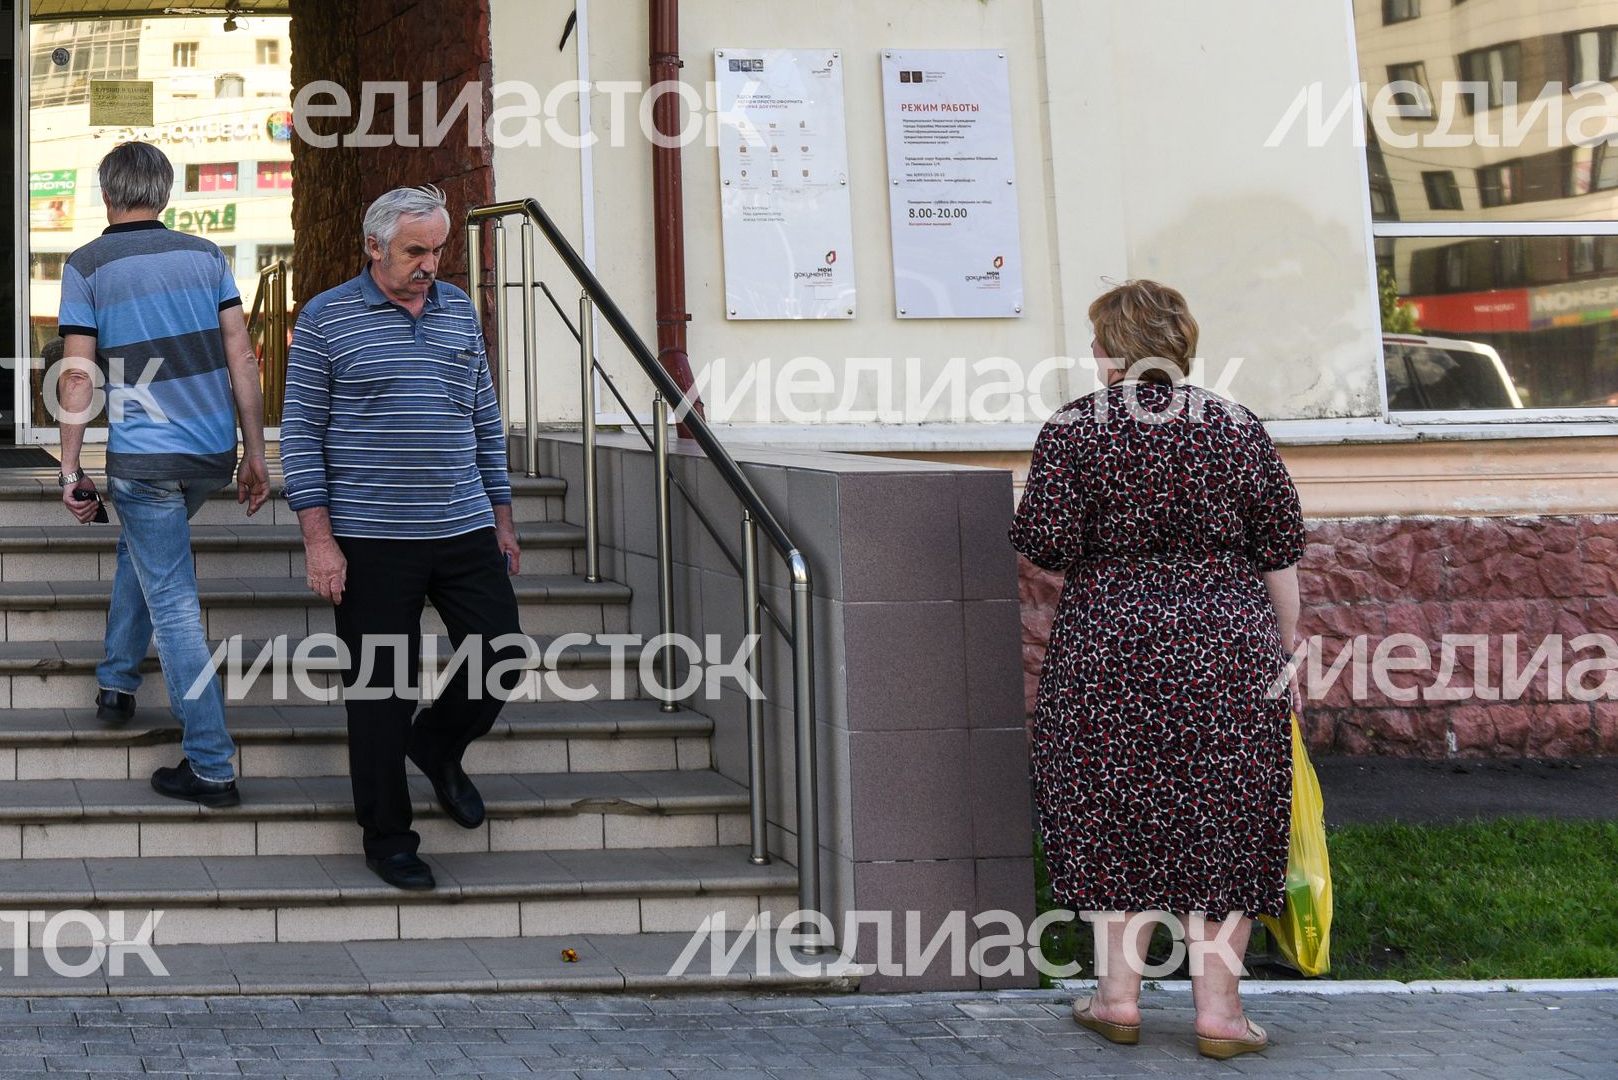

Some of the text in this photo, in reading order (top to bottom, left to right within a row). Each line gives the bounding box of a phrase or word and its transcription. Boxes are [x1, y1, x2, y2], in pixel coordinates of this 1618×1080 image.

[901, 104, 980, 112] РЕЖИМ РАБОТЫ
[908, 208, 968, 219] 8.00-20.00
